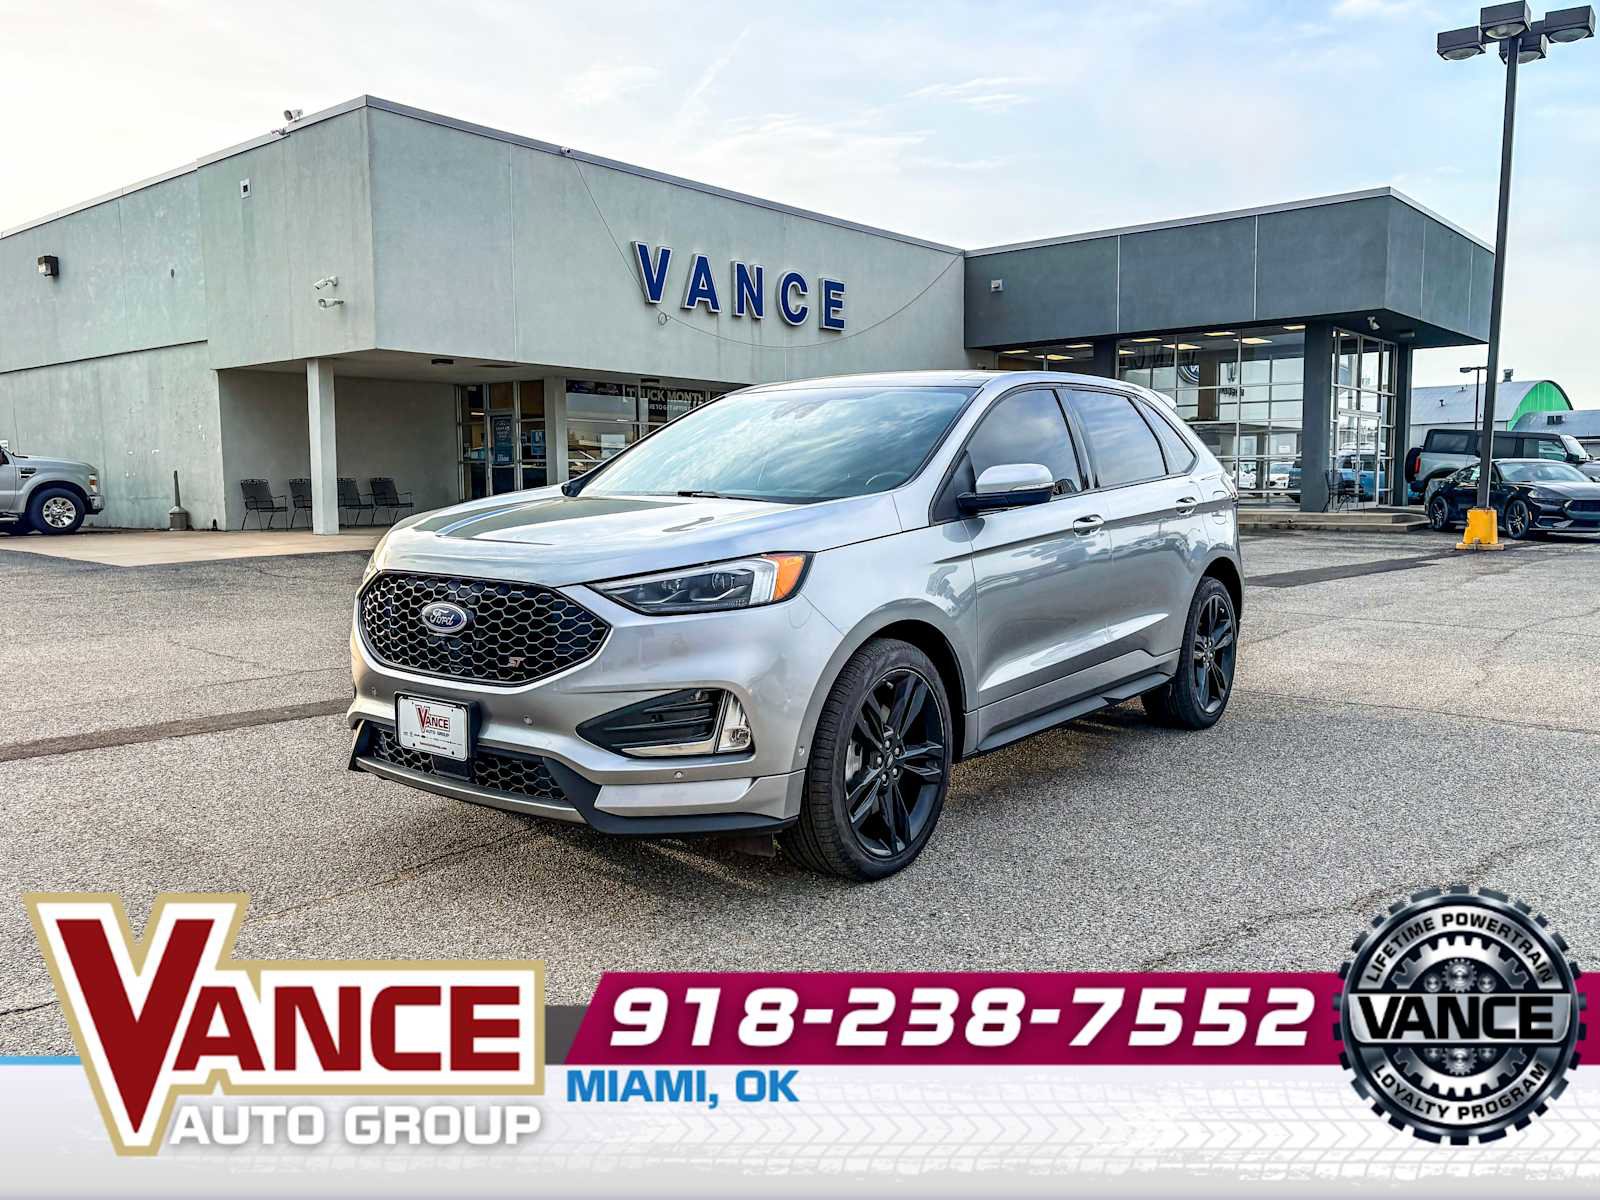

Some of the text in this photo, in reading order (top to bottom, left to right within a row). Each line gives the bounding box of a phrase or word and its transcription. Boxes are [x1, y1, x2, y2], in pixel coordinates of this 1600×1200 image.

[631, 240, 846, 331] VANCE
[626, 387, 666, 401] TUCK
[429, 608, 455, 626] Ford
[508, 656, 526, 668] ST
[416, 706, 450, 730] VANCE
